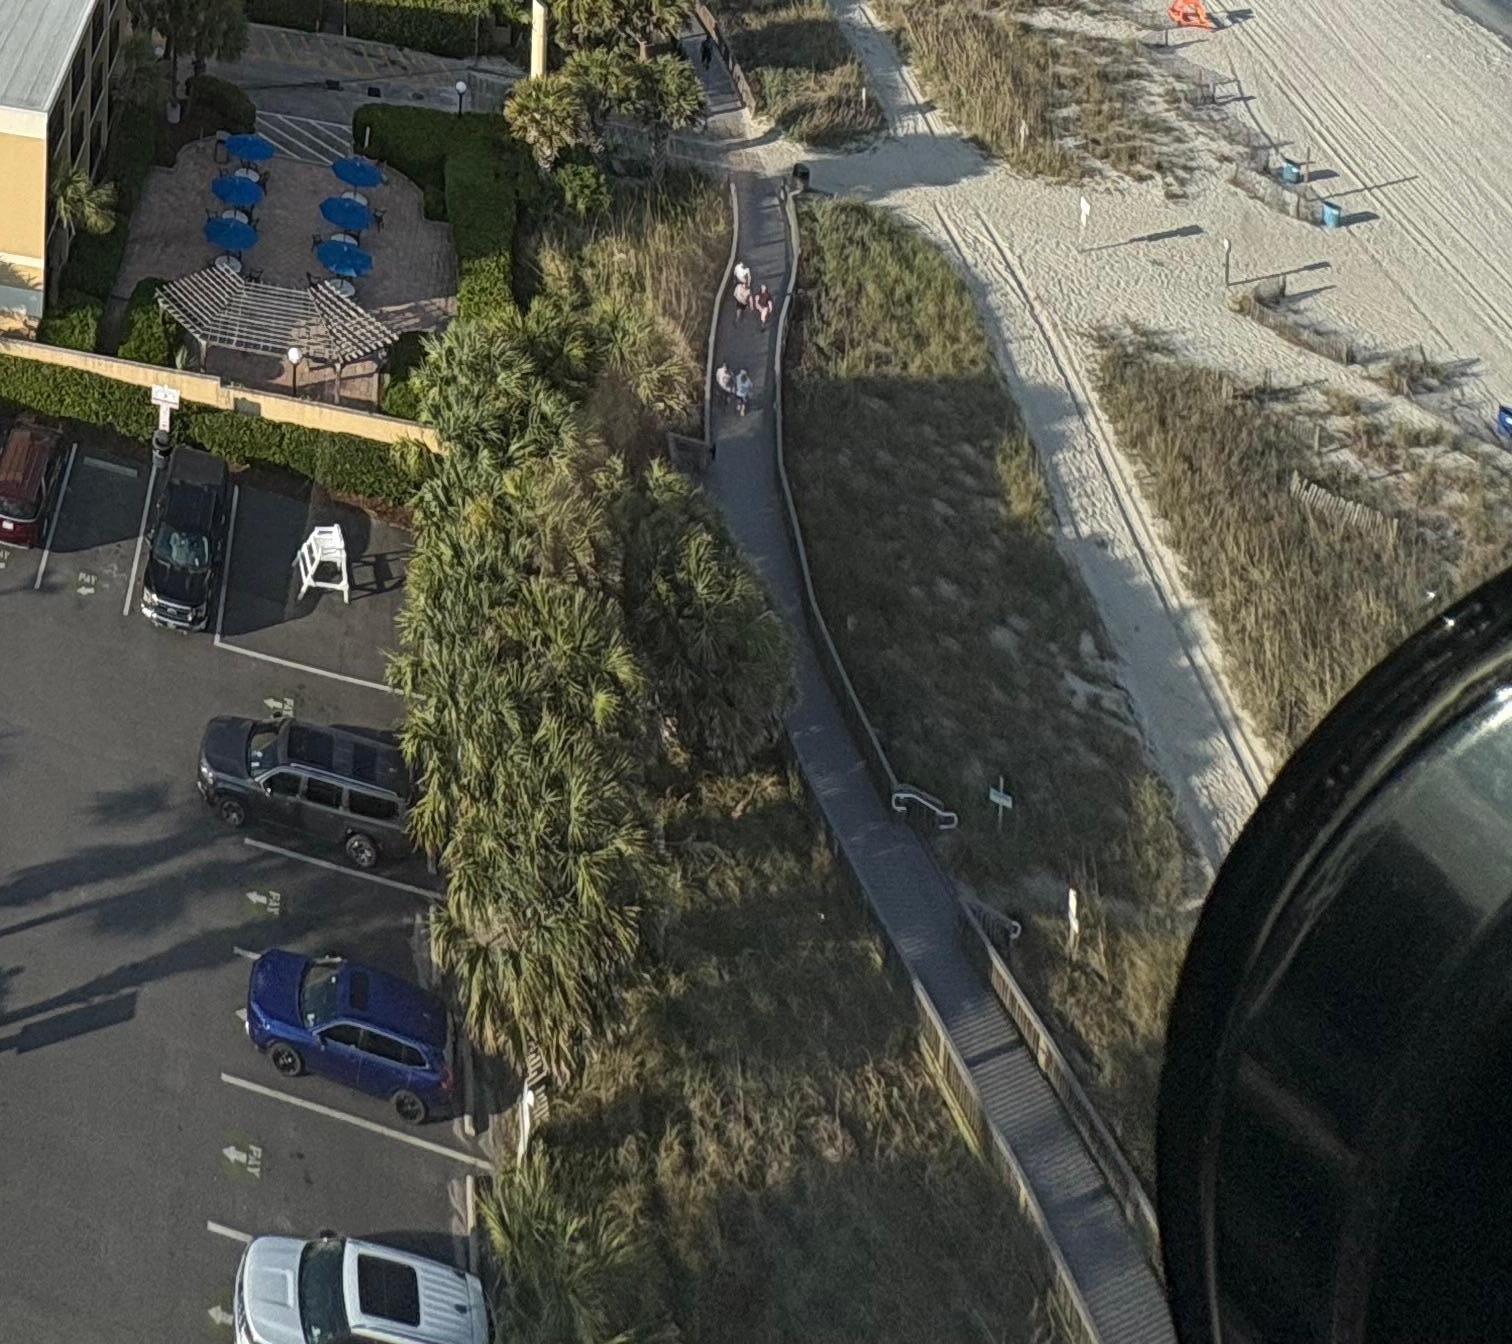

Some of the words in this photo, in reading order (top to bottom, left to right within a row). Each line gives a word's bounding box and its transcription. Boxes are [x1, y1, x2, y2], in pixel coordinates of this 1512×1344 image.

[78, 572, 98, 586] PAY
[266, 890, 281, 916] PAY
[246, 1144, 263, 1179] PAY
